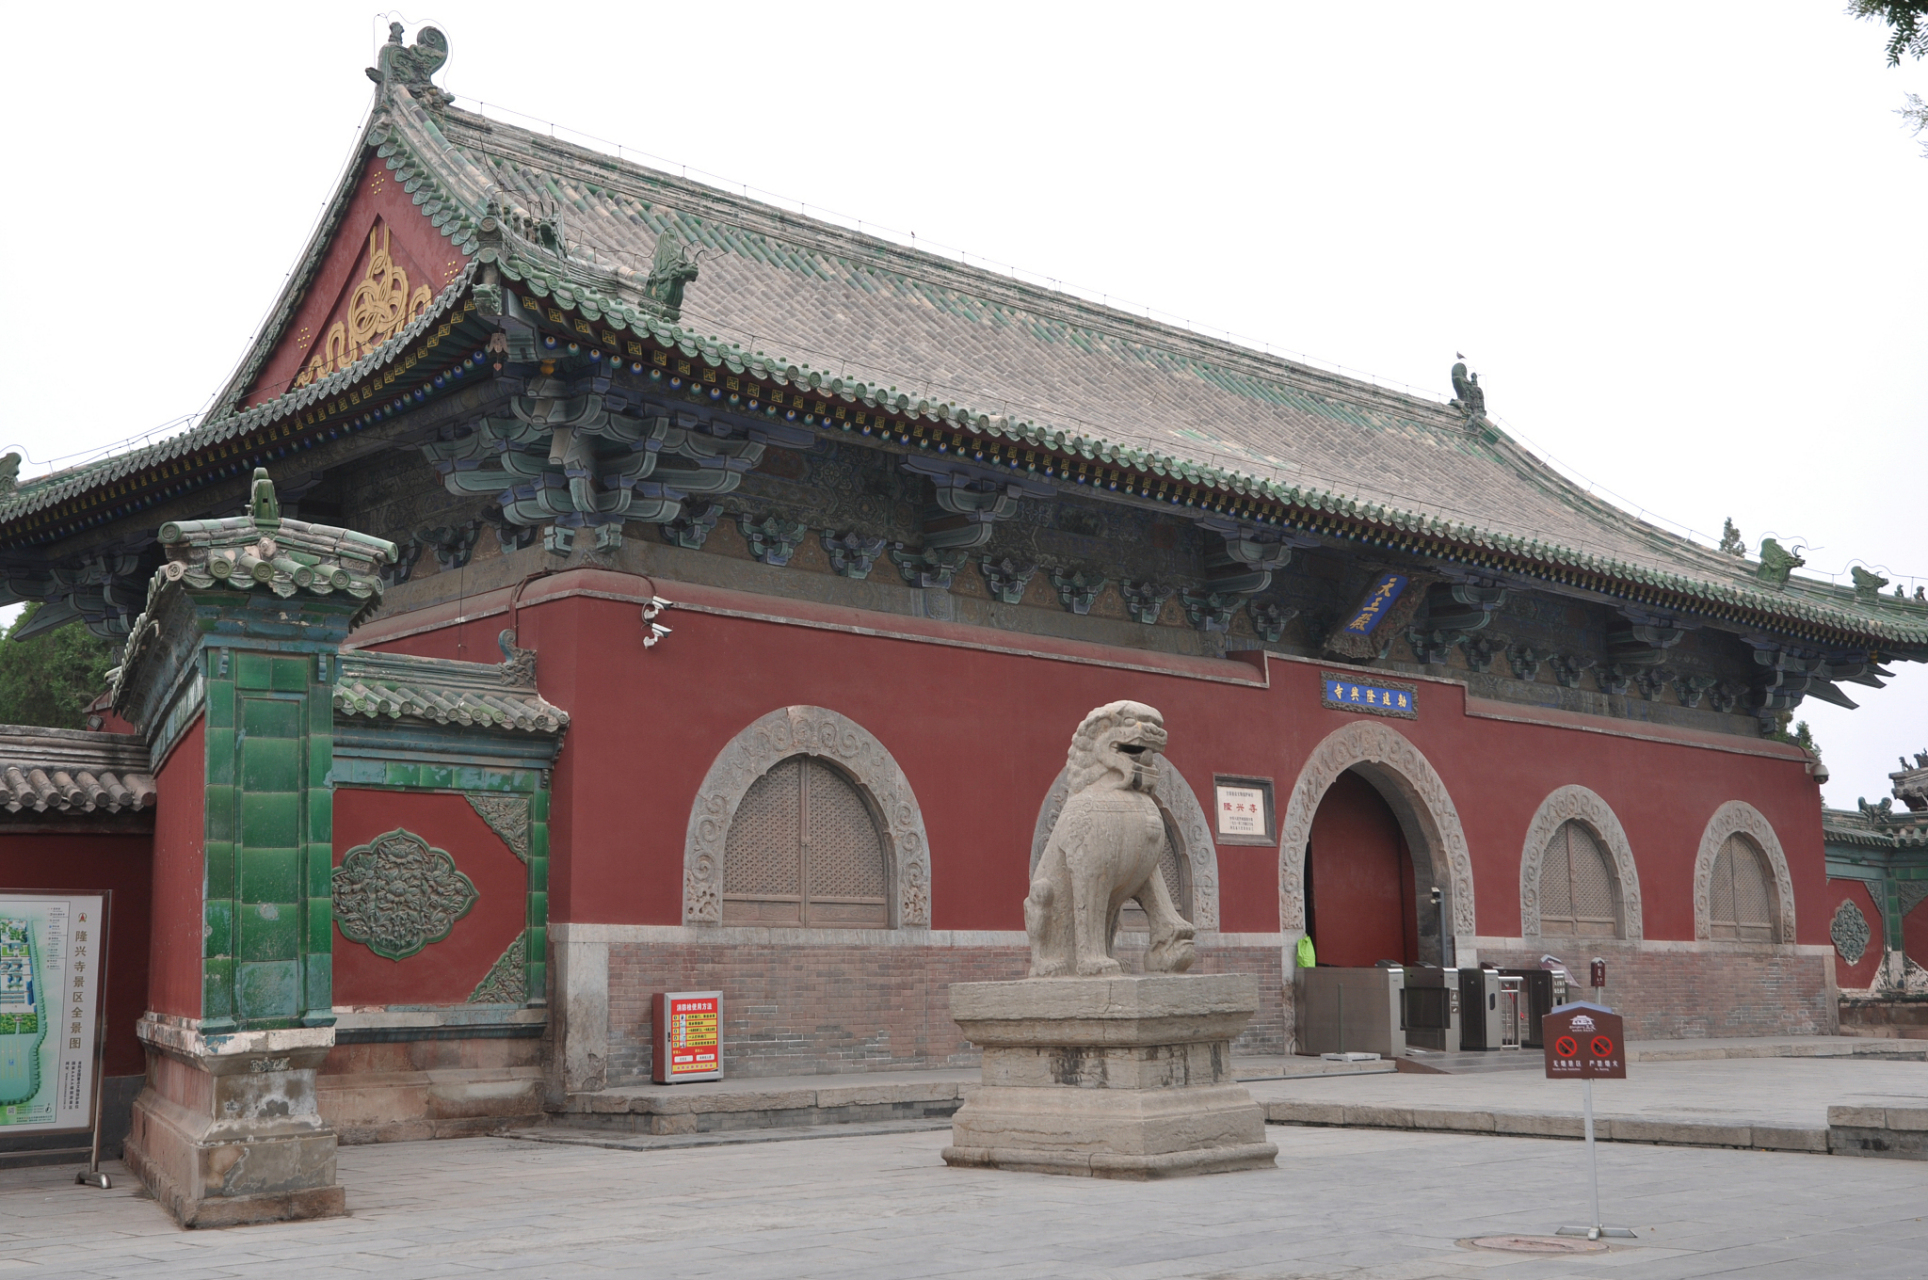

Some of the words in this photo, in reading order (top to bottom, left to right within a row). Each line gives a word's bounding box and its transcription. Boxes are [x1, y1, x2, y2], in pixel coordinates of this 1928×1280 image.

[1349, 577, 1398, 632] 天王殿
[1223, 802, 1258, 813] 隆兴寺
[69, 930, 88, 1050] 隆兴寺景区全景图
